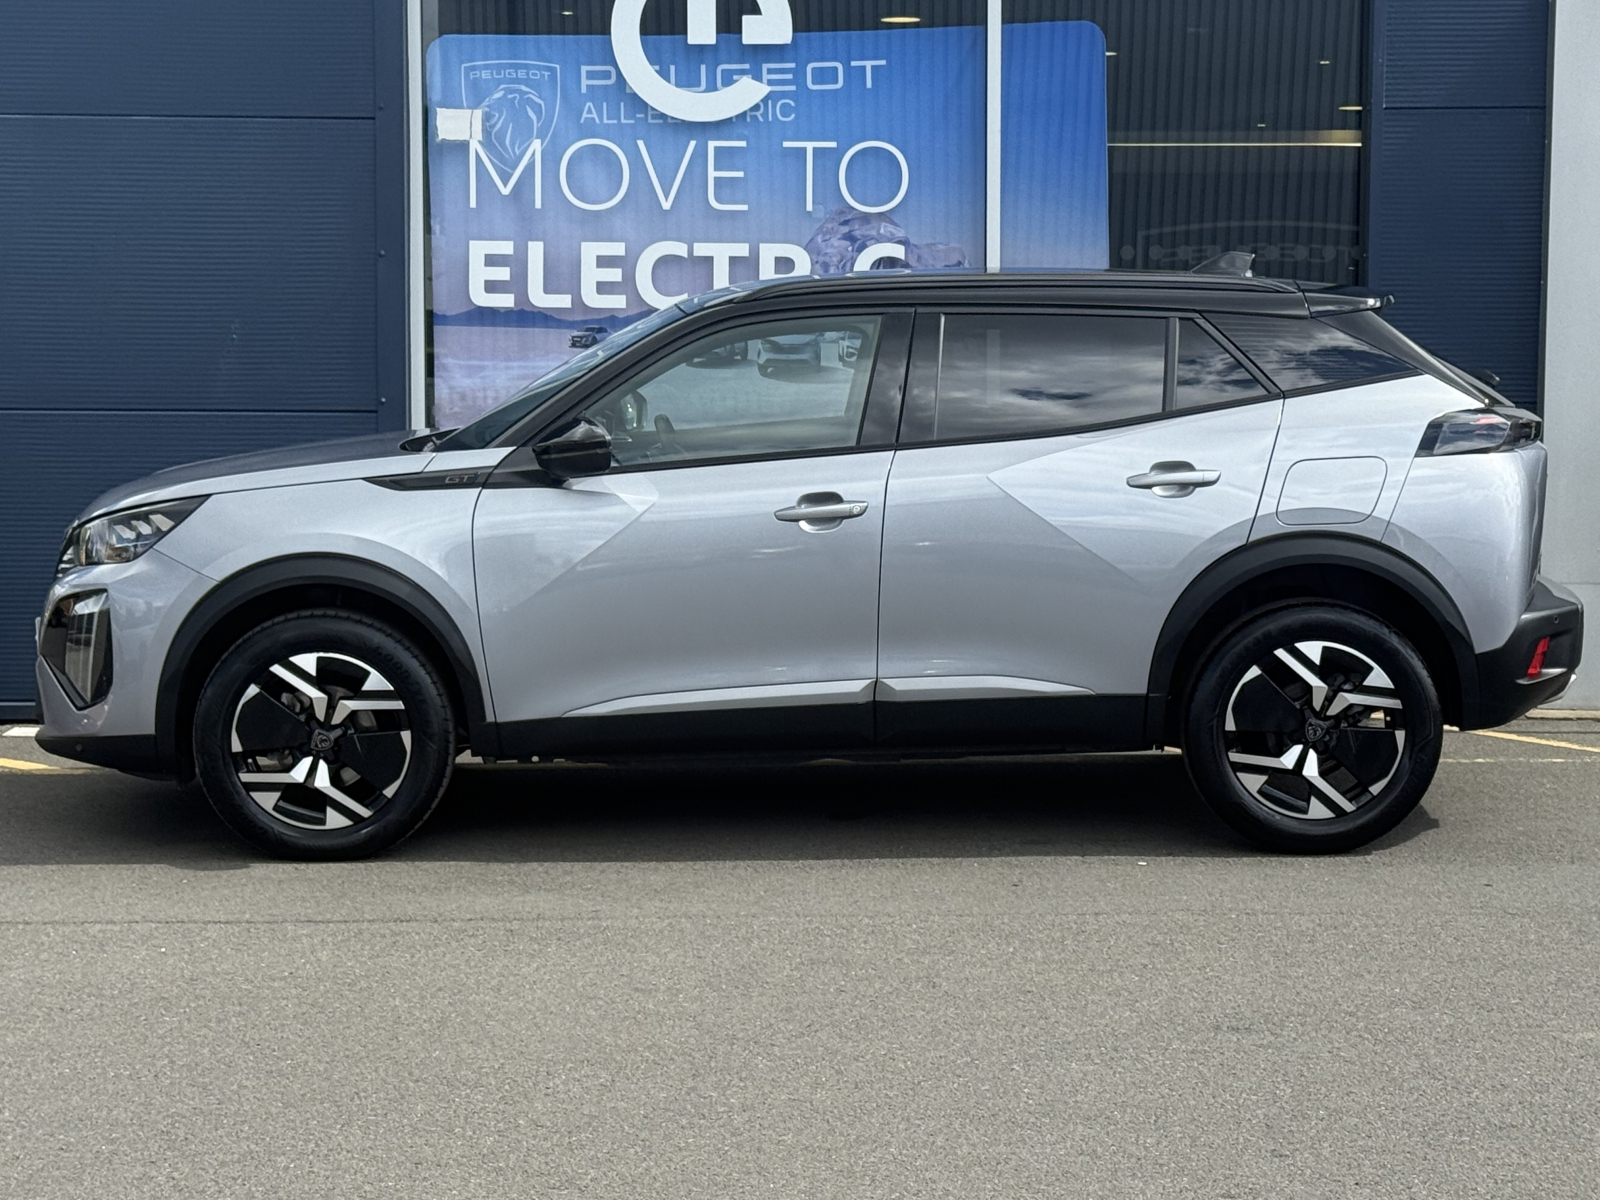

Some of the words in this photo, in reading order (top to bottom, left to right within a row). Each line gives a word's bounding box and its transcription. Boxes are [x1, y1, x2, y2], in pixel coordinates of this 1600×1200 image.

[469, 69, 551, 80] PEUGEOT
[580, 59, 887, 94] PUGEOT
[579, 99, 796, 124] ALL-ERIC
[469, 137, 749, 211] MOVE
[782, 140, 909, 213] TO
[468, 240, 905, 309] ELECTR
[444, 474, 475, 484] GT
